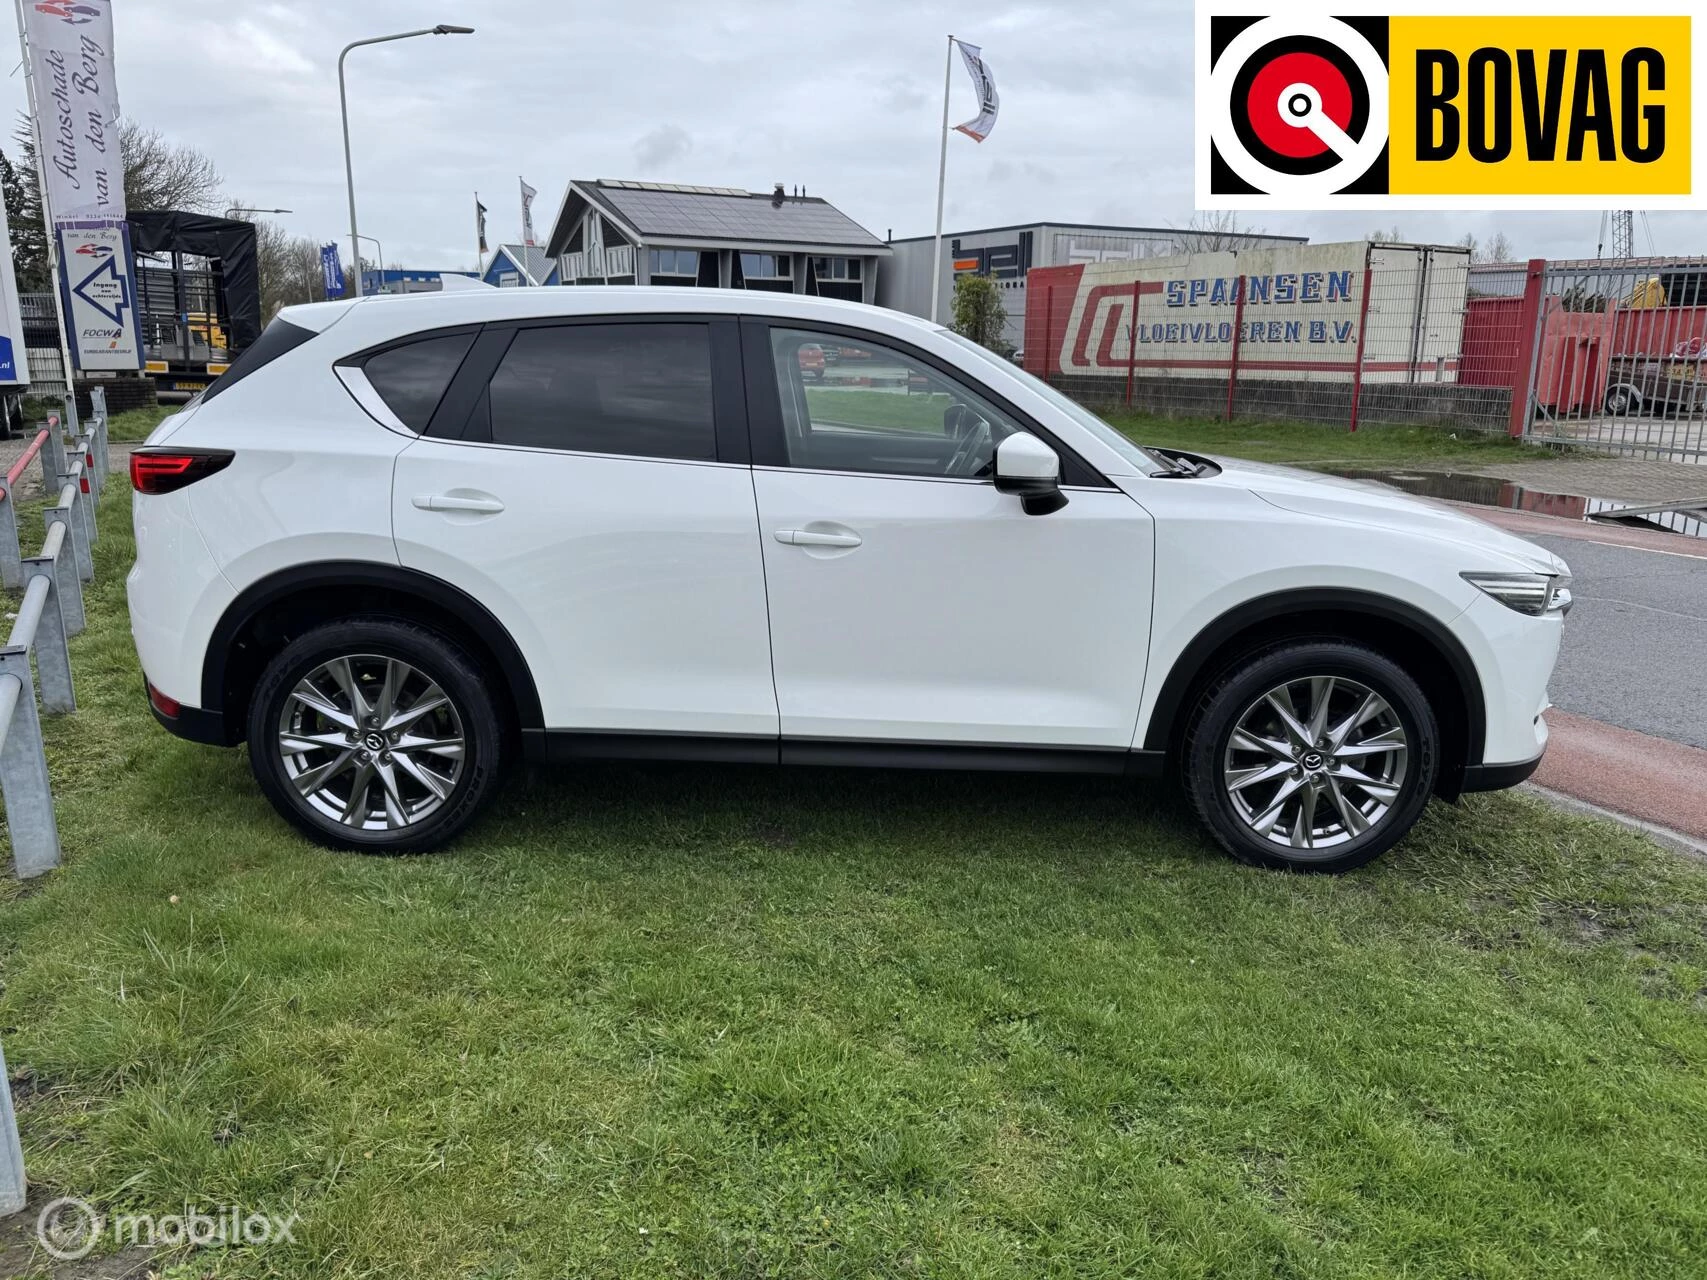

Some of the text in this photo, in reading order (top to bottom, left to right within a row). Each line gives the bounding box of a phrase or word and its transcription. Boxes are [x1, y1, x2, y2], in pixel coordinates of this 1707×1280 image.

[72, 35, 105, 96] Berg
[45, 50, 80, 189] Autoschade
[85, 110, 106, 153] den
[94, 167, 109, 207] van
[1166, 270, 1353, 307] SPAANSEN
[83, 328, 122, 338] FOCWA
[1307, 319, 1357, 343] B.V.
